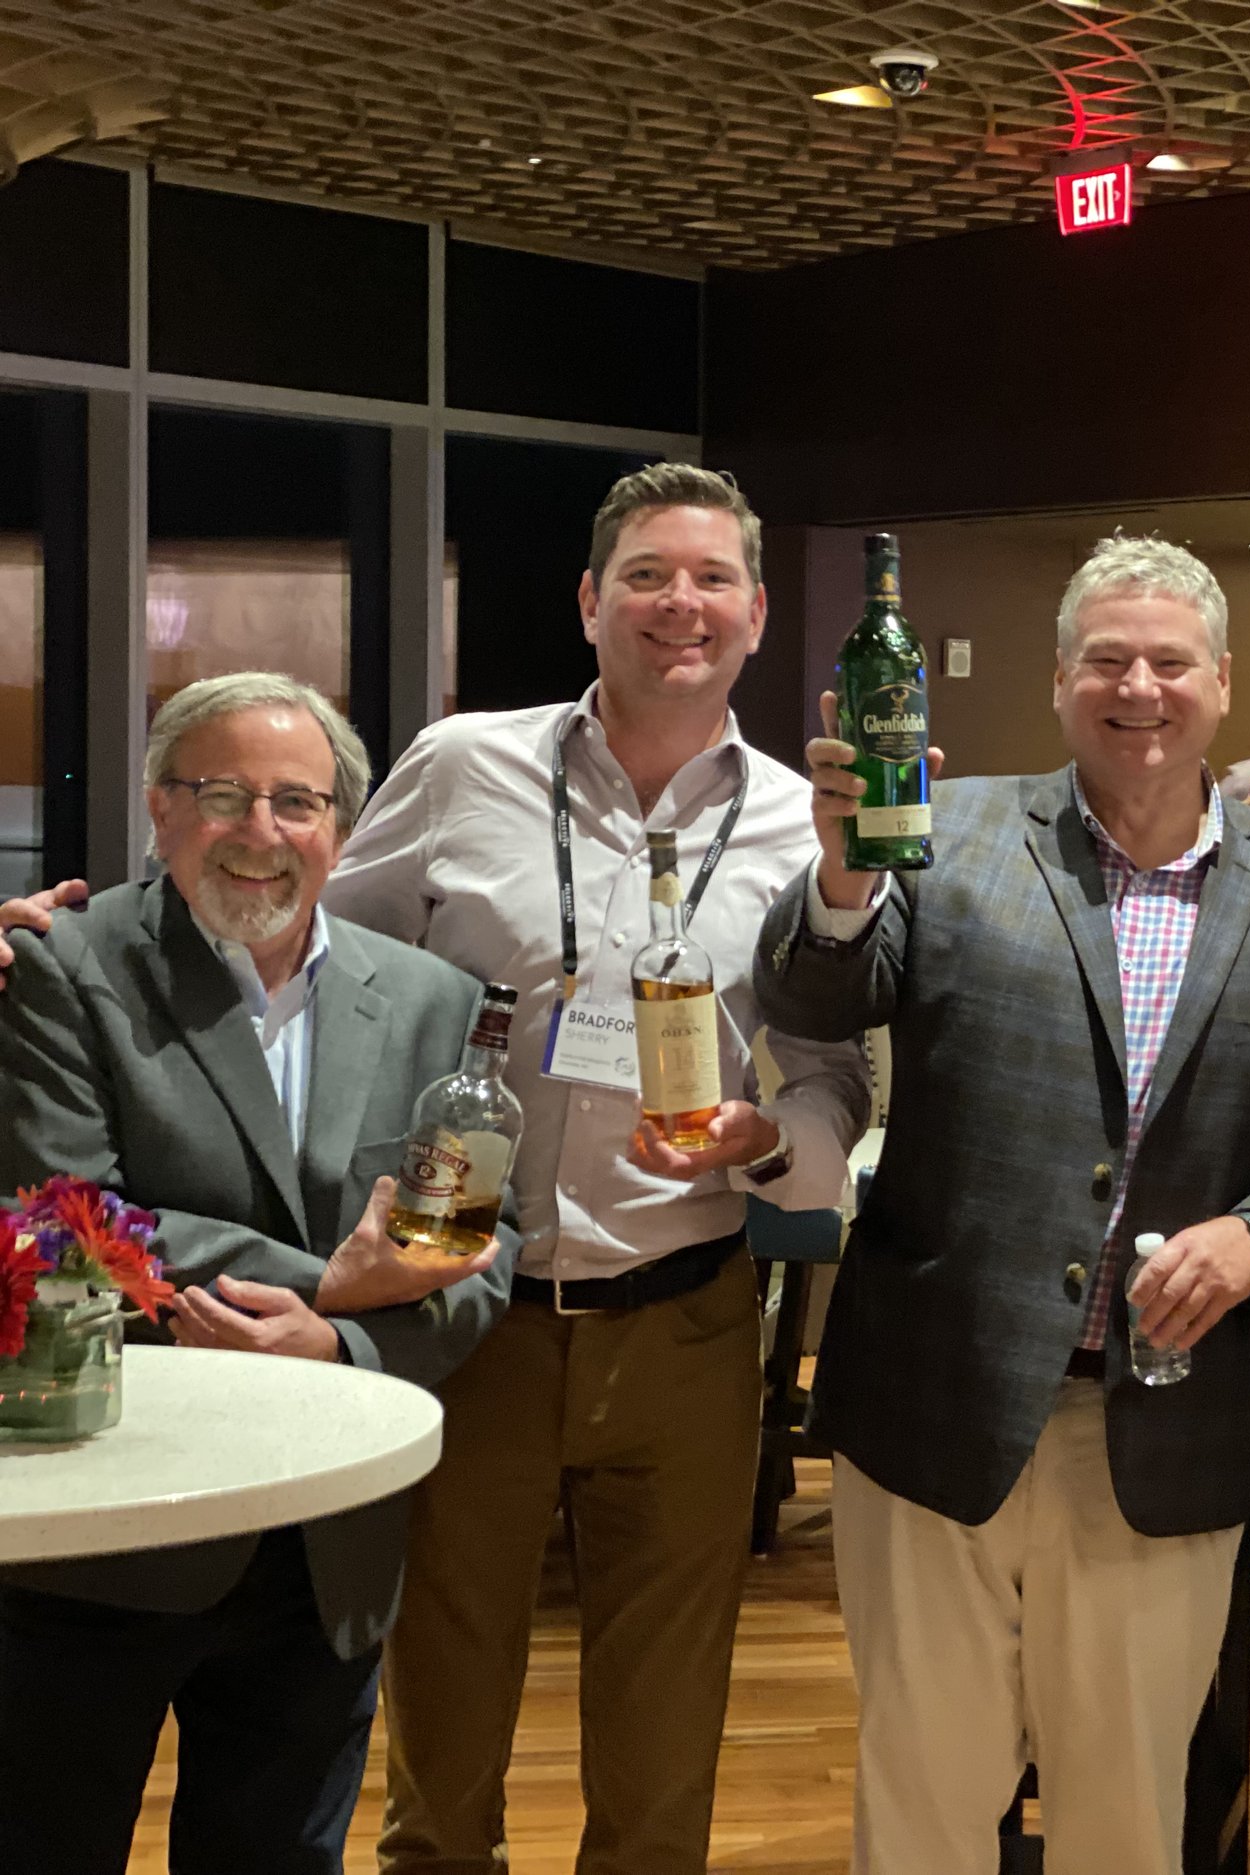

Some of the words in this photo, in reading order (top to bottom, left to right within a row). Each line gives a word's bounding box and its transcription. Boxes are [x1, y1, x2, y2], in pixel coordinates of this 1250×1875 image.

[1072, 173, 1117, 226] EXIT
[863, 712, 926, 734] Glenfiddich
[896, 819, 909, 833] 12
[568, 1010, 636, 1035] BRADFOR
[565, 1028, 610, 1045] SHERRY
